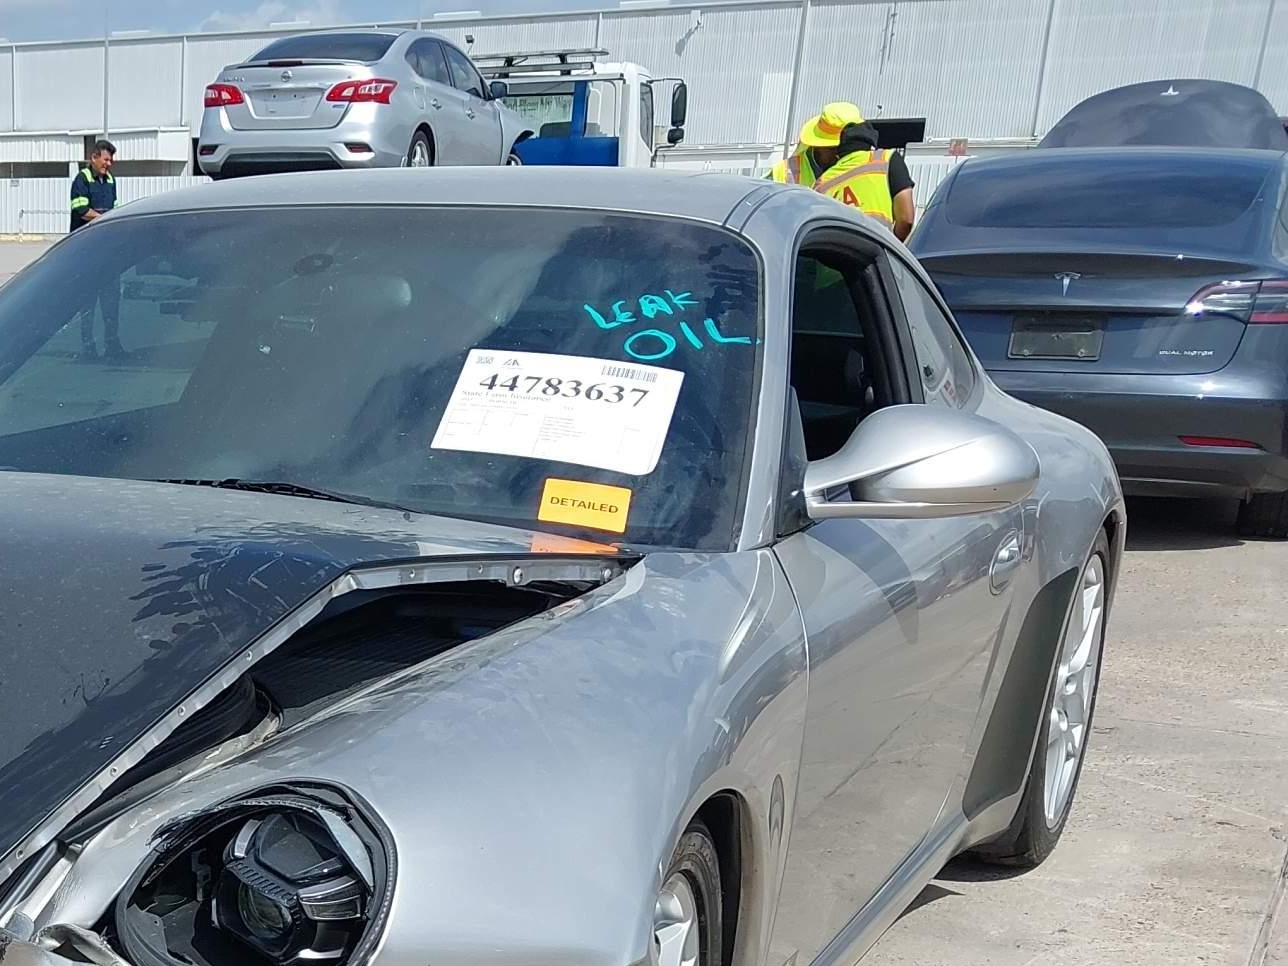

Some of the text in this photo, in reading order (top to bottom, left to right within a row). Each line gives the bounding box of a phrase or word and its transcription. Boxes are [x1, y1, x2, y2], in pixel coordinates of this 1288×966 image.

[584, 290, 699, 329] LEAK
[624, 318, 751, 360] OIL
[479, 373, 649, 407] 44783637
[550, 496, 619, 513] DETAILED
